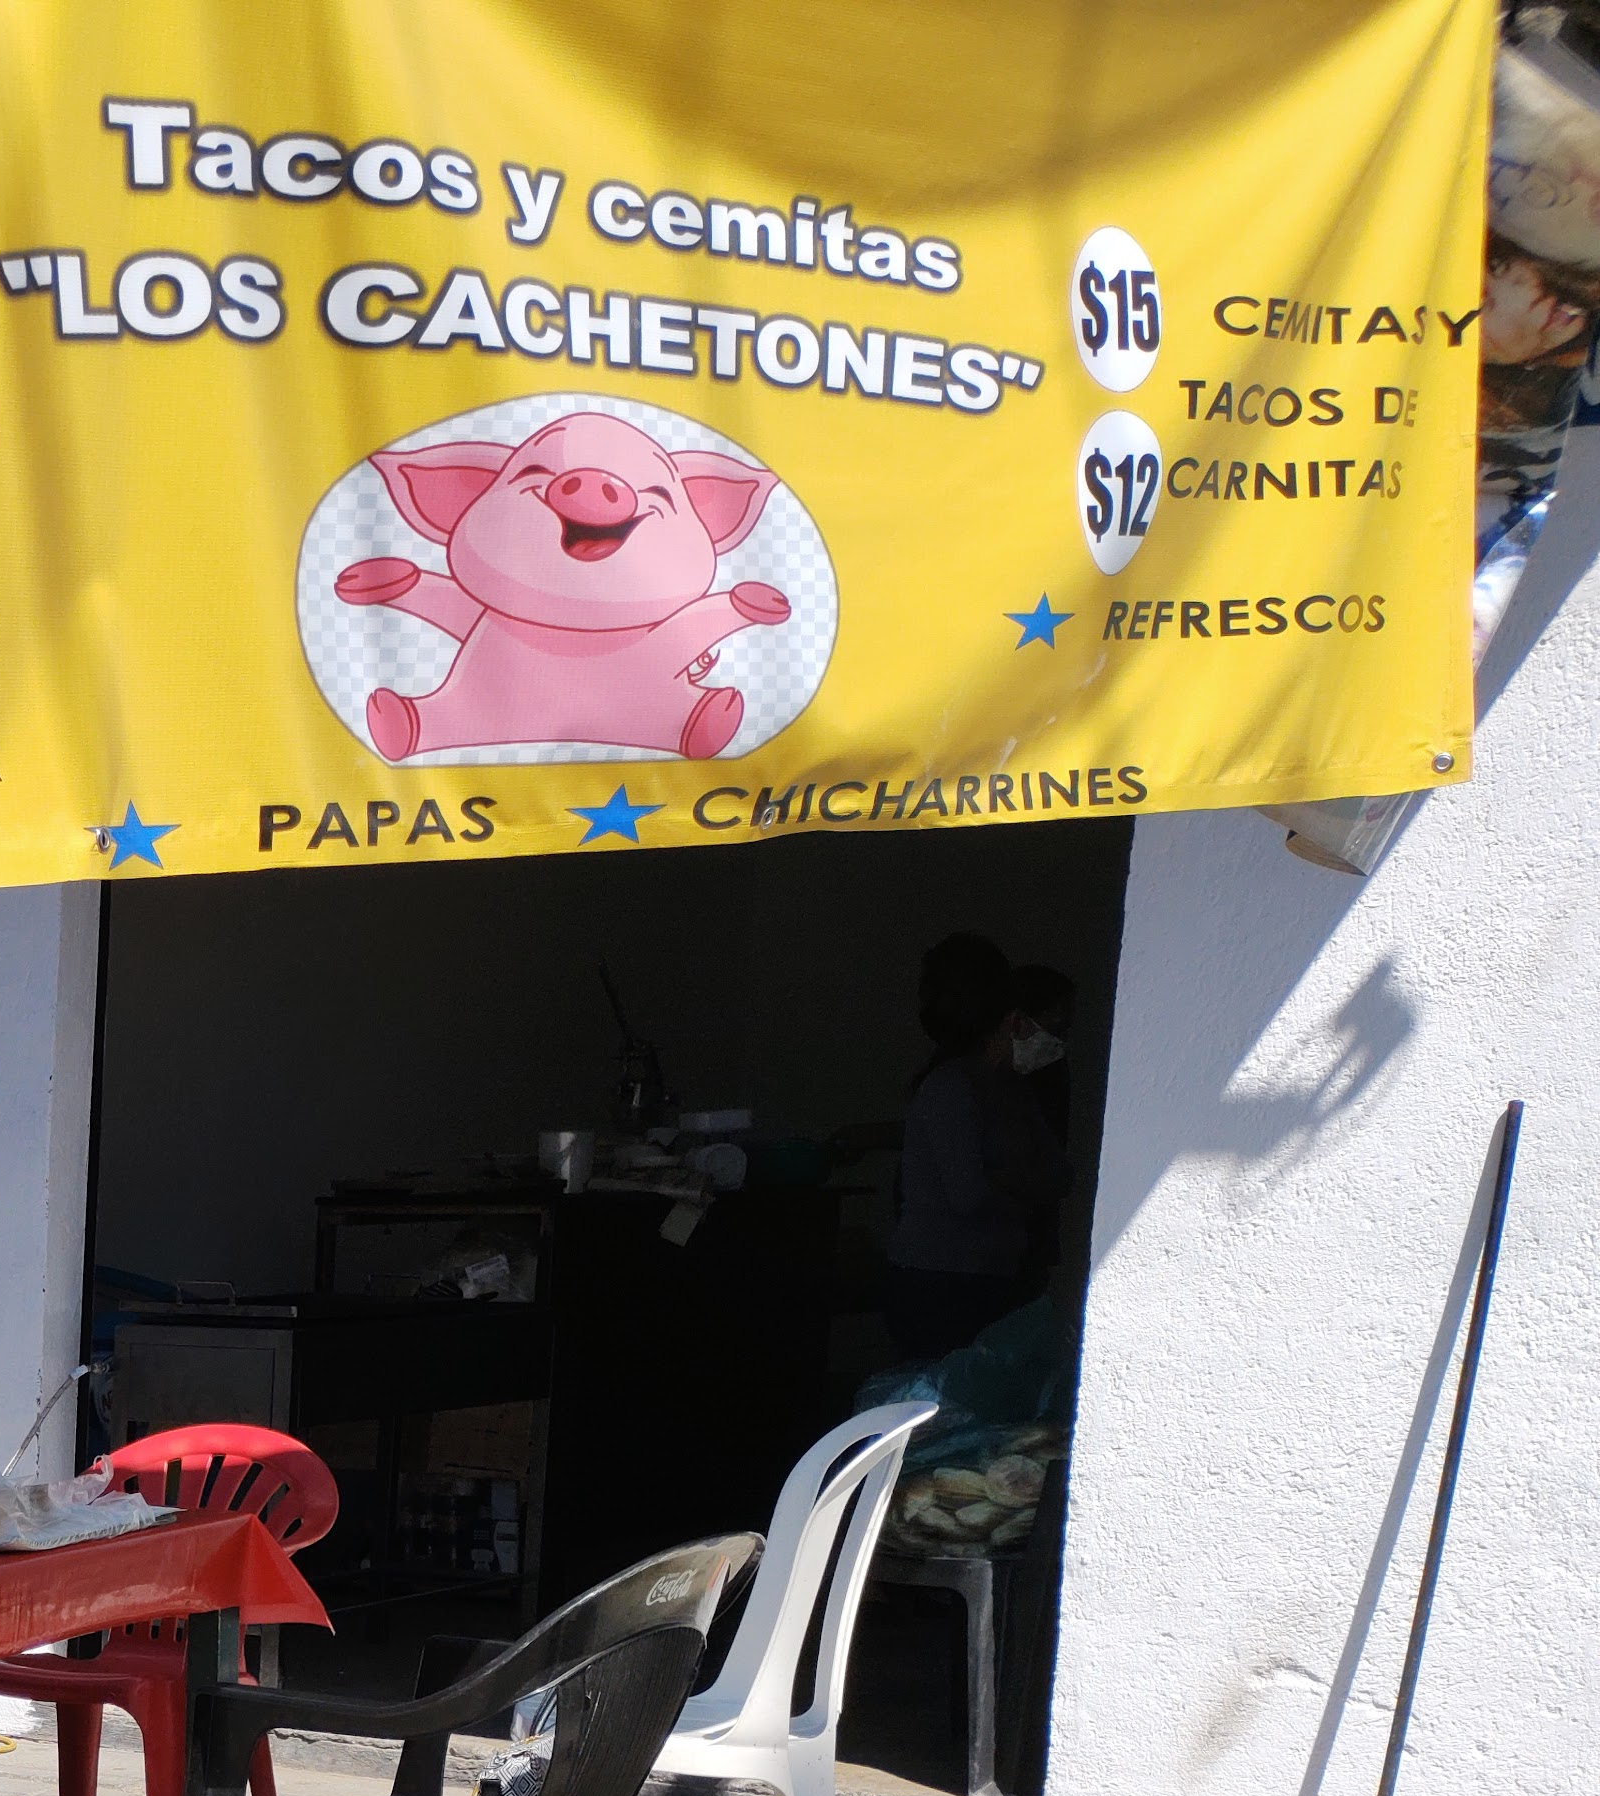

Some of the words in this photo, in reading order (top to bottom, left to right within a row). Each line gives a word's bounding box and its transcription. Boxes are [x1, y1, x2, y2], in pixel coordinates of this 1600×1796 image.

[105, 97, 480, 212] Tacos
[502, 167, 563, 244] y
[591, 184, 962, 292] cemitas
[0, 252, 283, 340] "LOS
[321, 266, 1042, 414] CACHETONES"
[1078, 261, 1159, 357] $15
[1213, 296, 1426, 346] CEMITAS
[1437, 308, 1483, 346] Y
[1178, 380, 1344, 427] TACOS
[1374, 386, 1418, 429] DE
[1084, 447, 1157, 543] $12
[1168, 458, 1402, 501] CARNITAS
[1103, 594, 1387, 641] REFRESCOS
[259, 796, 498, 852] PAPAS
[693, 765, 1148, 831] CHICHARRINES
